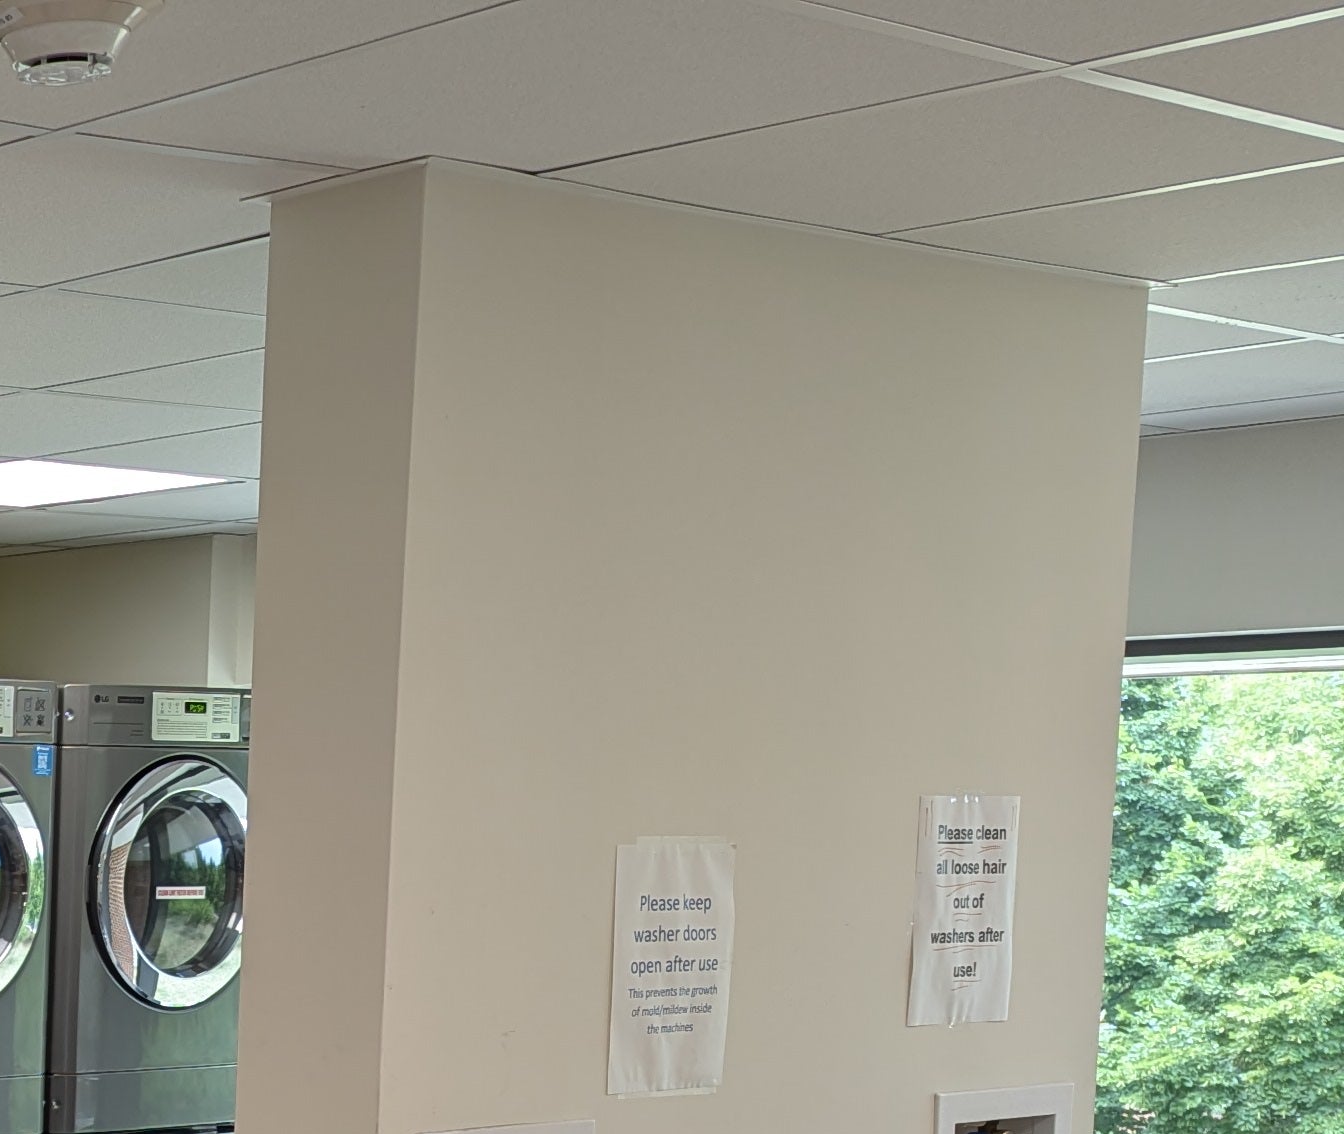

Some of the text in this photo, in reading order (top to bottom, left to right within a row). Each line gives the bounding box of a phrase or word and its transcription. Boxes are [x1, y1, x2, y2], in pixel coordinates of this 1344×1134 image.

[938, 825, 1007, 841] Please clean
[936, 859, 1007, 875] all loose hair
[639, 894, 713, 914] Please keep
[953, 894, 985, 909] out of
[634, 924, 717, 943] washer doors
[931, 927, 1005, 944] washers after
[631, 955, 719, 977] open after use
[953, 962, 977, 978] use!
[628, 986, 718, 1000] This prevents the growth
[632, 1004, 713, 1017] of mold/mildew inside
[647, 1023, 694, 1035] the machines
